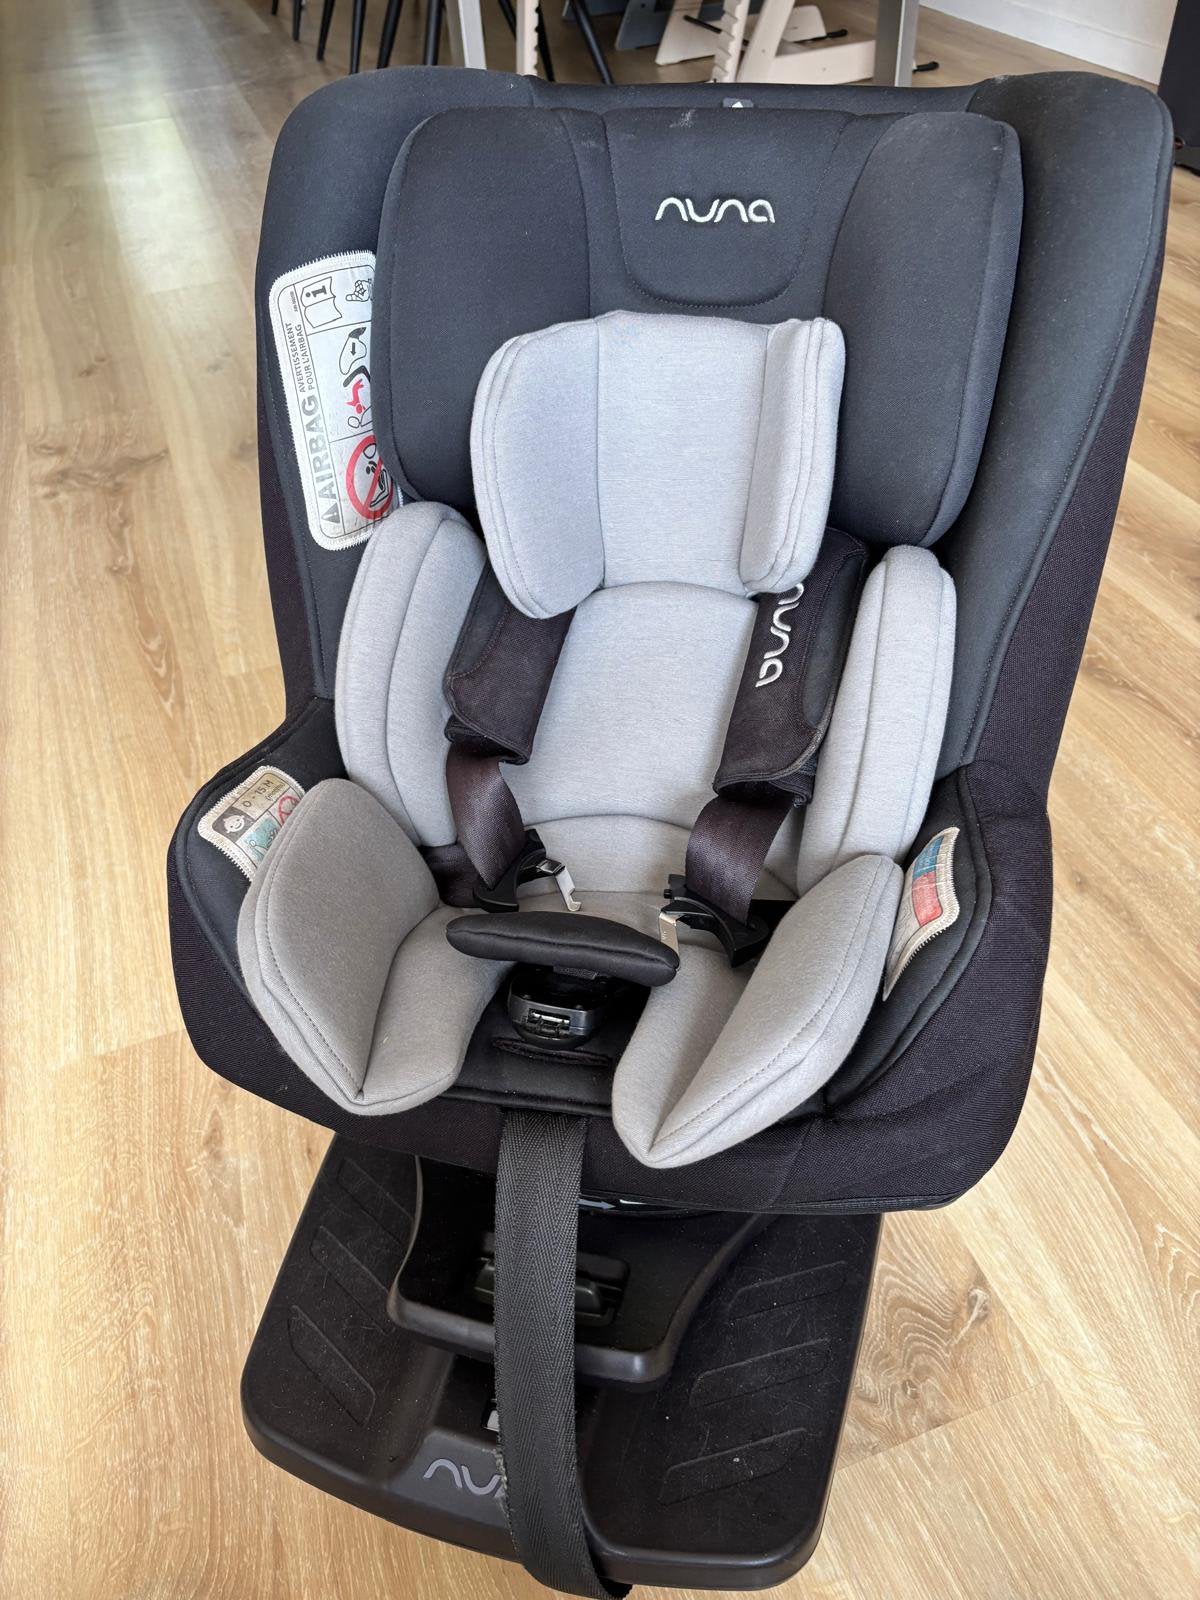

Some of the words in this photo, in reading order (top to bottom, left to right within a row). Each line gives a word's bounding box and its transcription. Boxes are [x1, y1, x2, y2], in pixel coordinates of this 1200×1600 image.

[655, 197, 775, 223] nuna
[285, 322, 305, 393] AVERTISSEMENT
[298, 324, 312, 364] L'AIRBAG
[304, 365, 315, 391] POUR
[301, 395, 336, 500] AIRBAG
[755, 582, 804, 688] nuna
[423, 1458, 506, 1498] nu
